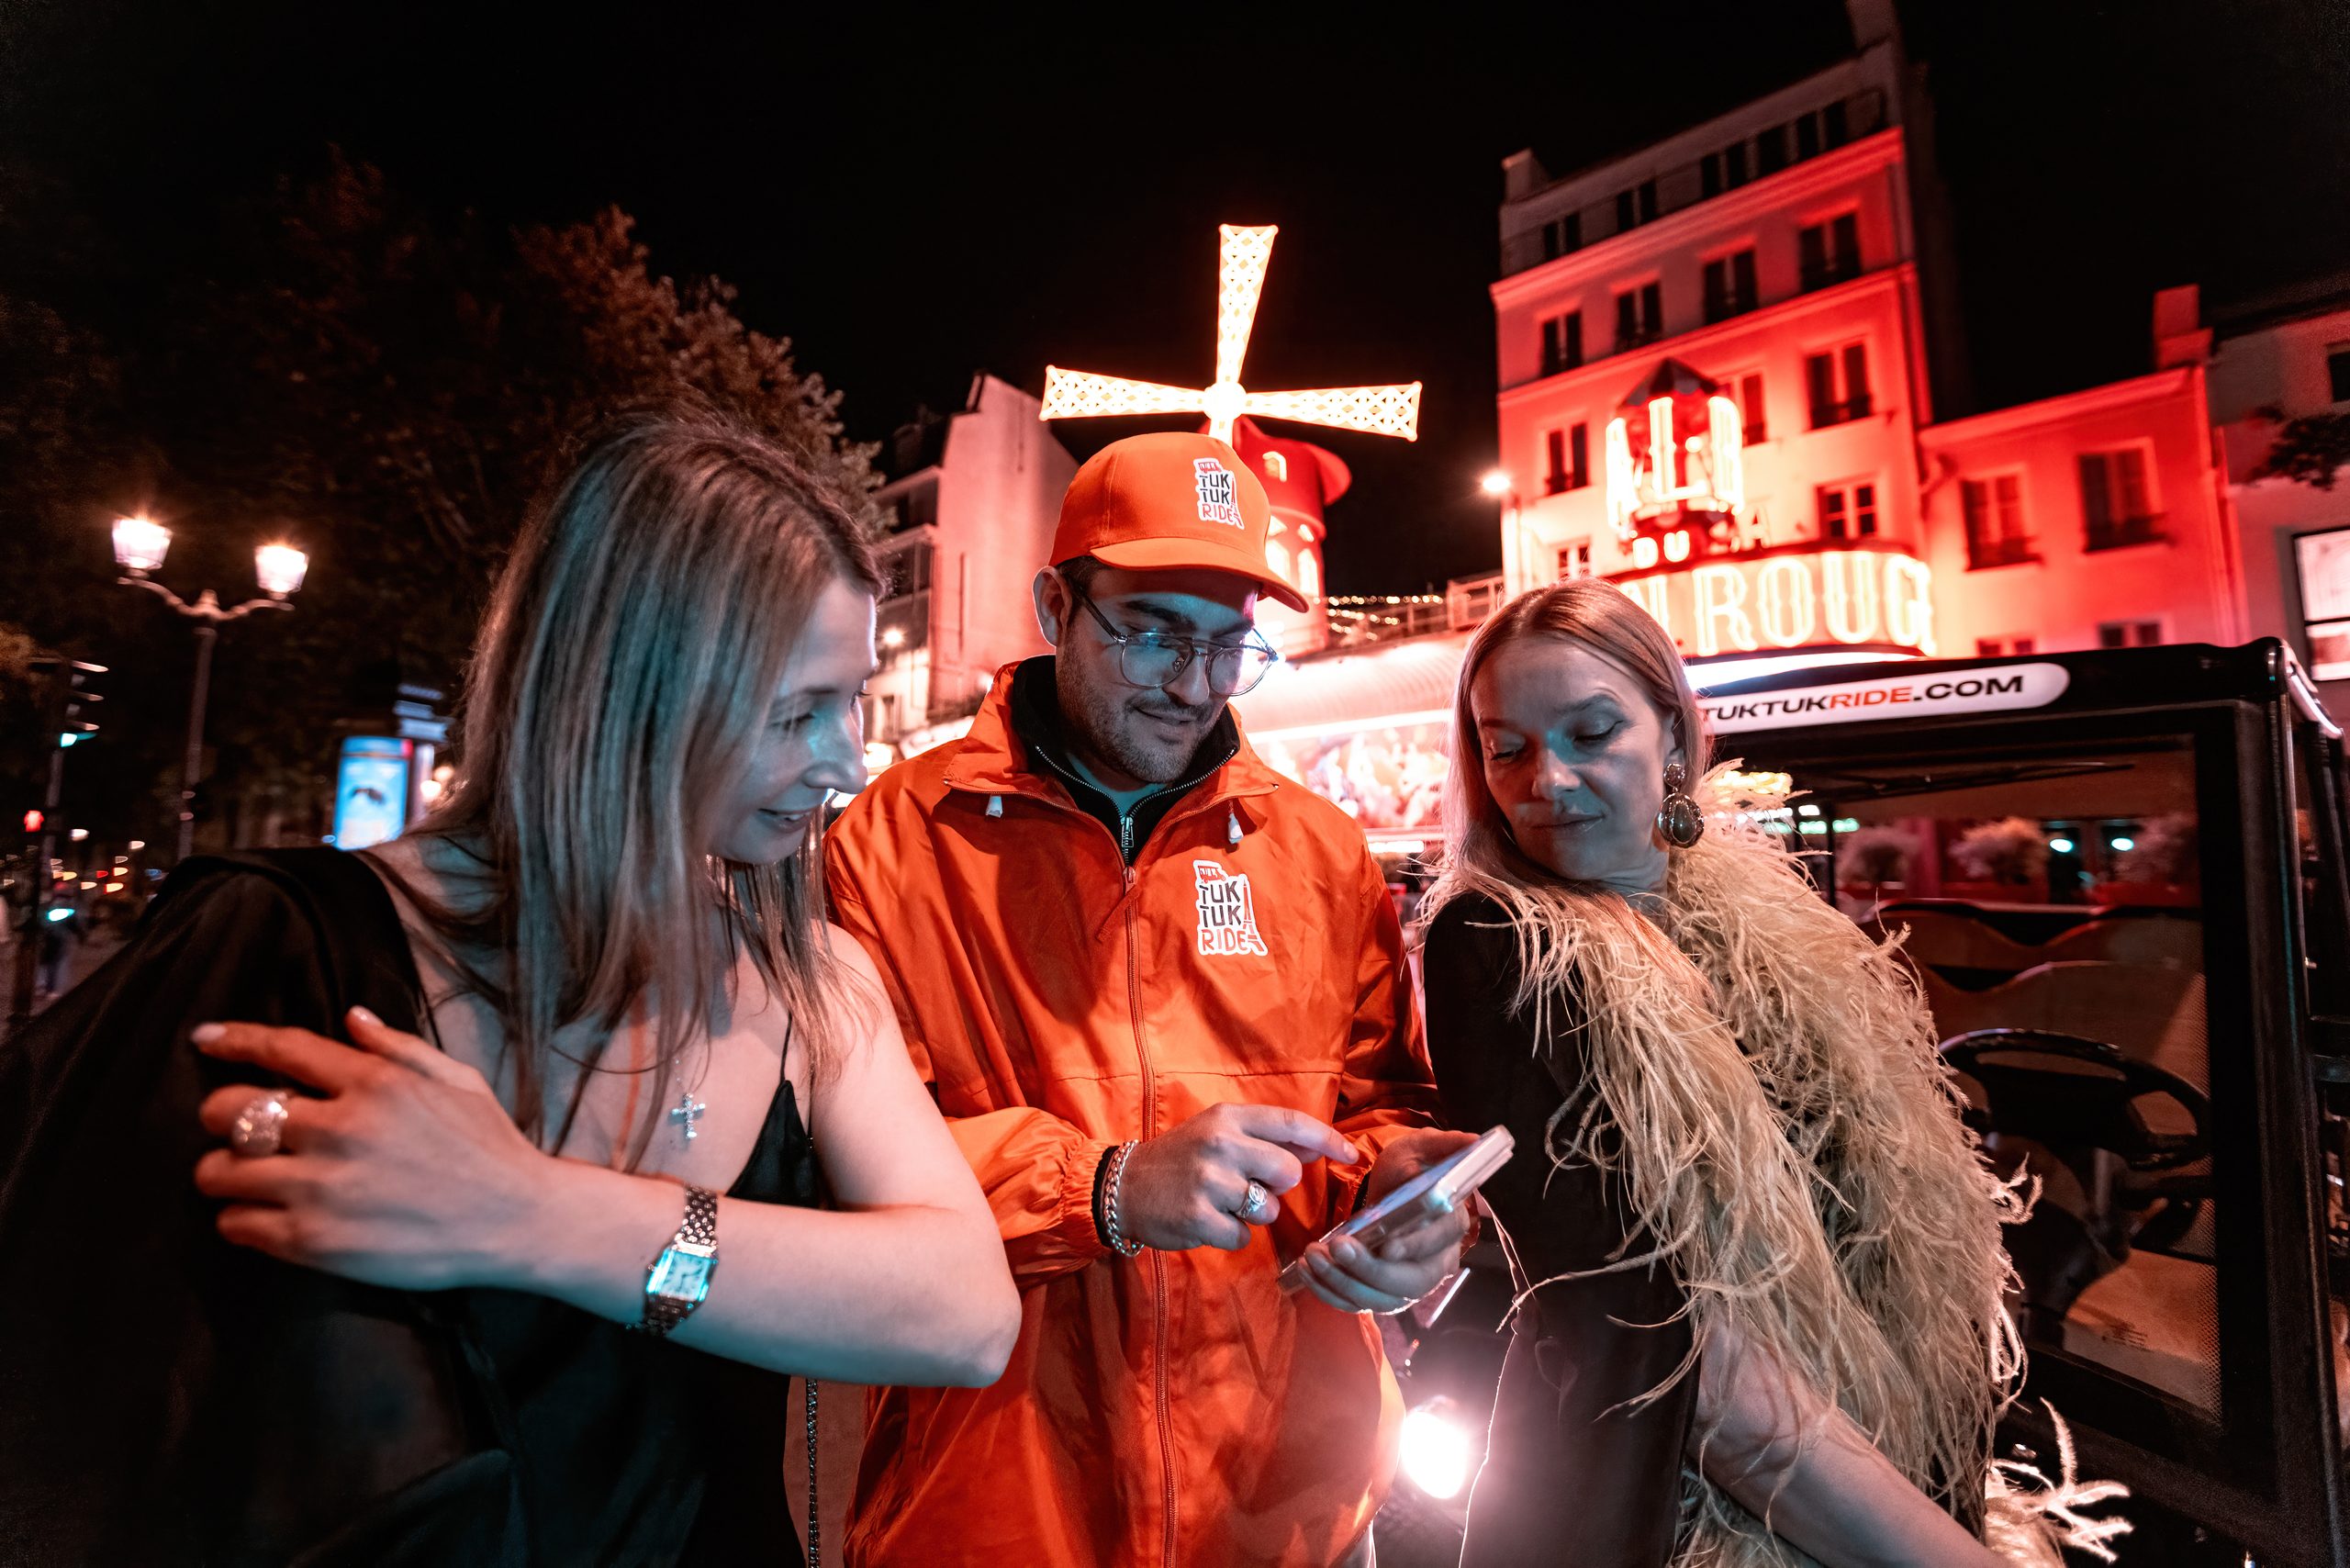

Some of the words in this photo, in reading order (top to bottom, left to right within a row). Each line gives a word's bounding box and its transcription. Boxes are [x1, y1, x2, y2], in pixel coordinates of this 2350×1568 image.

[1199, 473, 1230, 489] TUK
[1199, 488, 1230, 505] TUK
[1202, 503, 1234, 522] RIDE
[1199, 880, 1241, 905] TUK
[1199, 904, 1242, 928] TUK
[1201, 927, 1248, 952] RIDE
